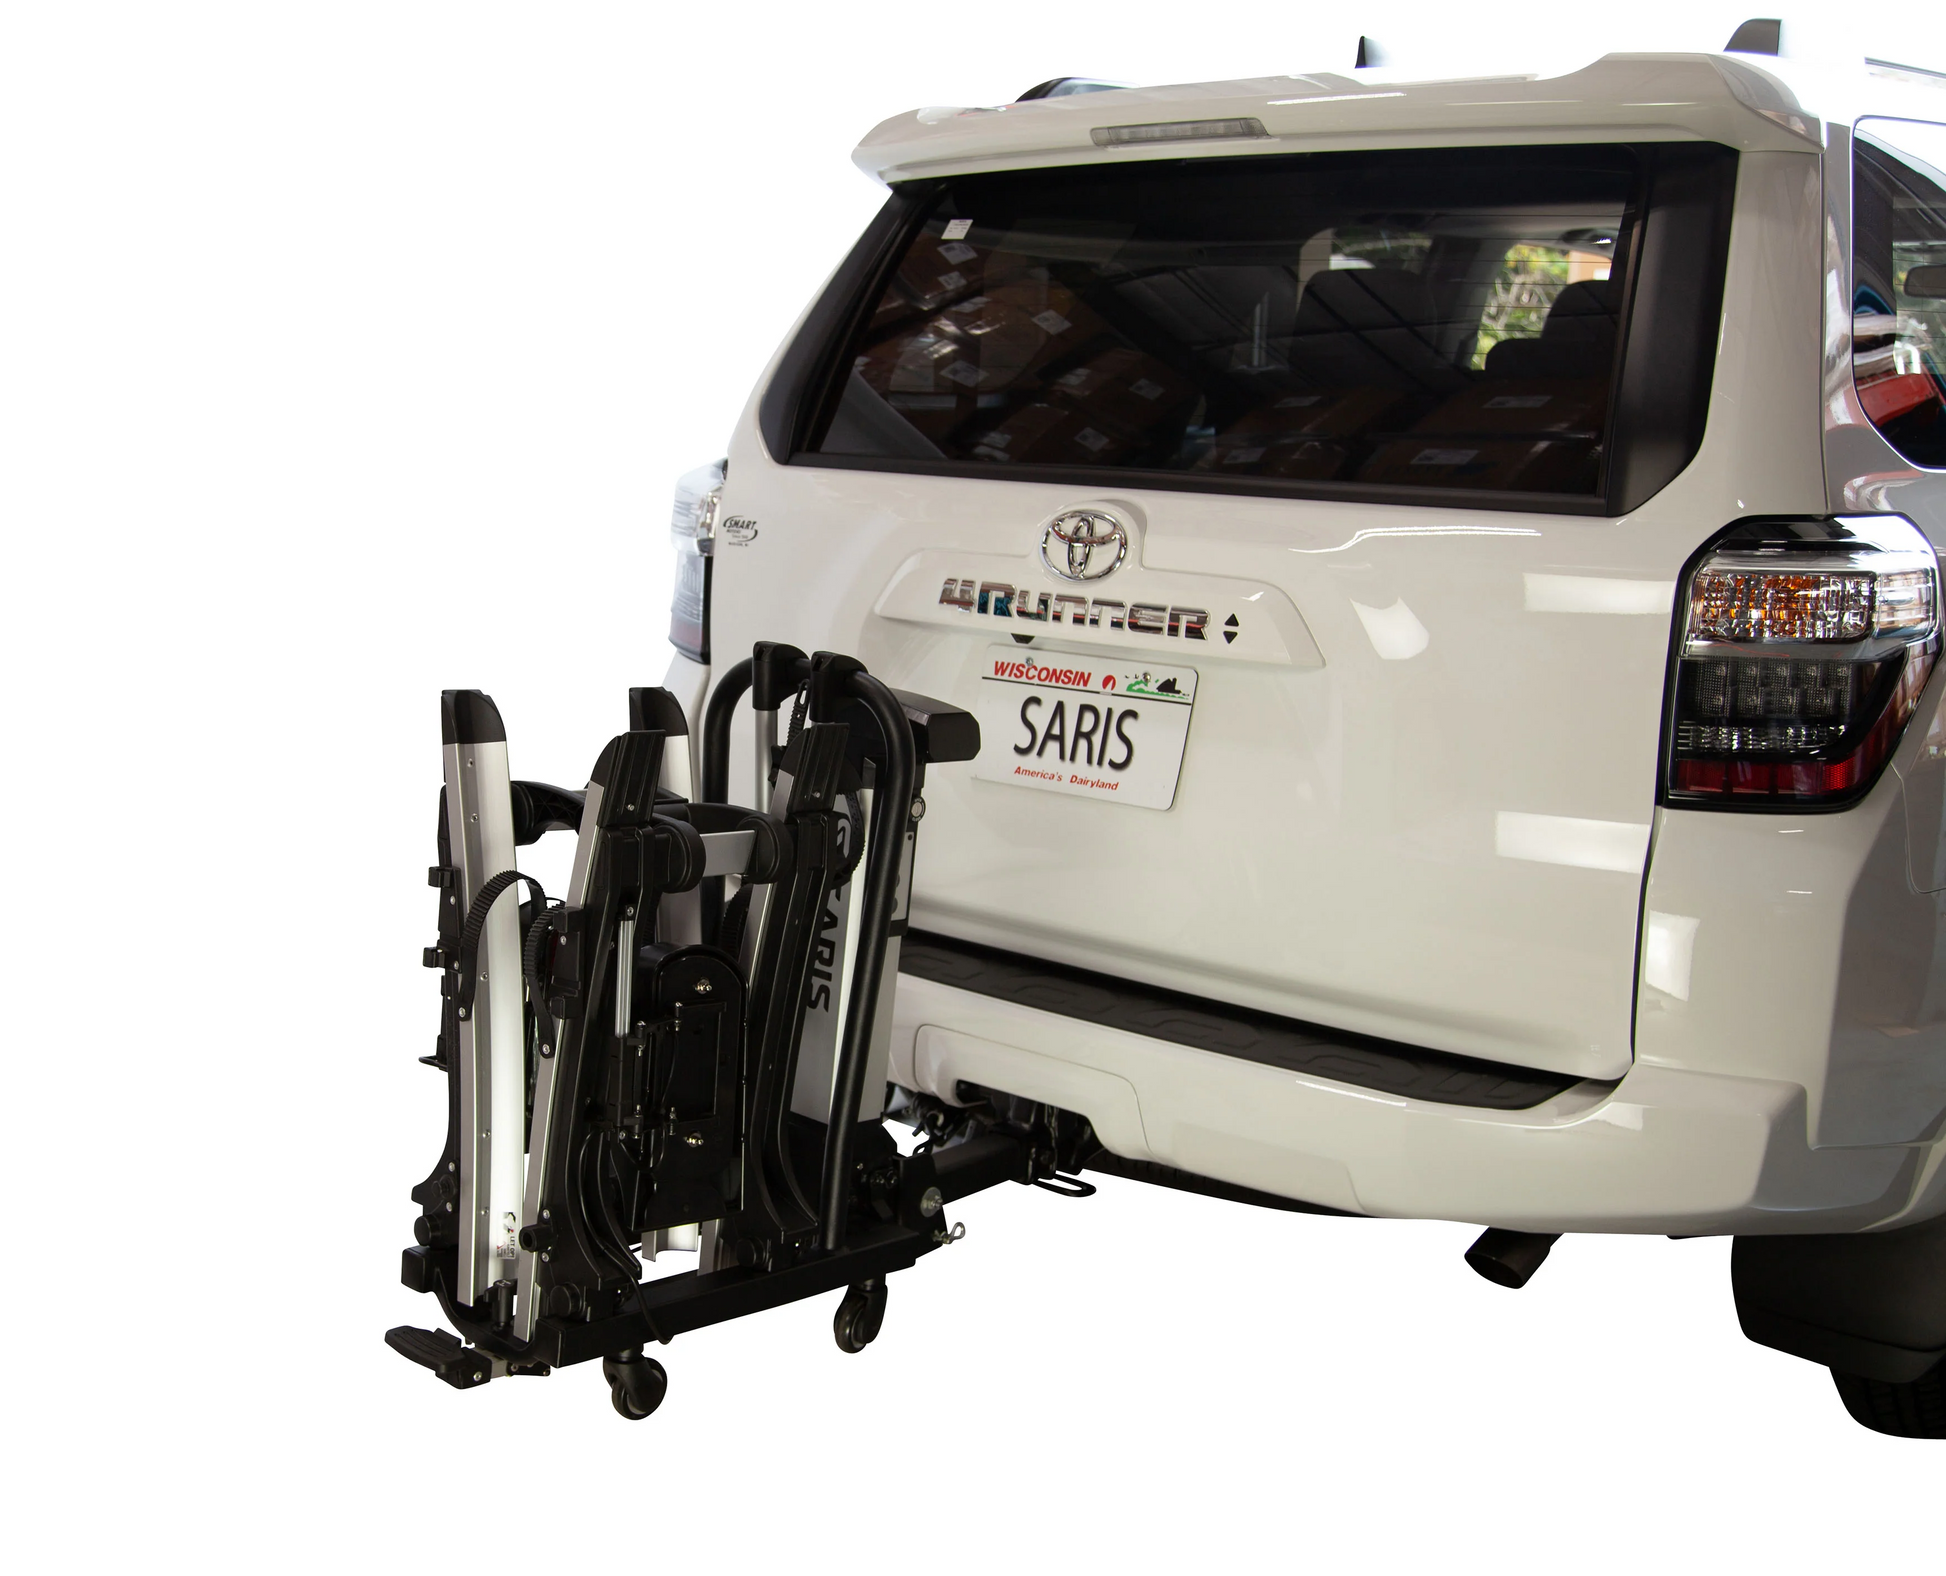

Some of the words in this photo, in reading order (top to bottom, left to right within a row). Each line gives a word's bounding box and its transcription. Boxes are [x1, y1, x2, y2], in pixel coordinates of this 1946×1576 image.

[728, 519, 757, 530] SMART
[993, 660, 1091, 687] WISCONSIN
[1013, 695, 1139, 770] SARIS
[1014, 766, 1063, 782] America's
[1069, 774, 1119, 791] Dairyland
[807, 886, 842, 1013] ARIS
